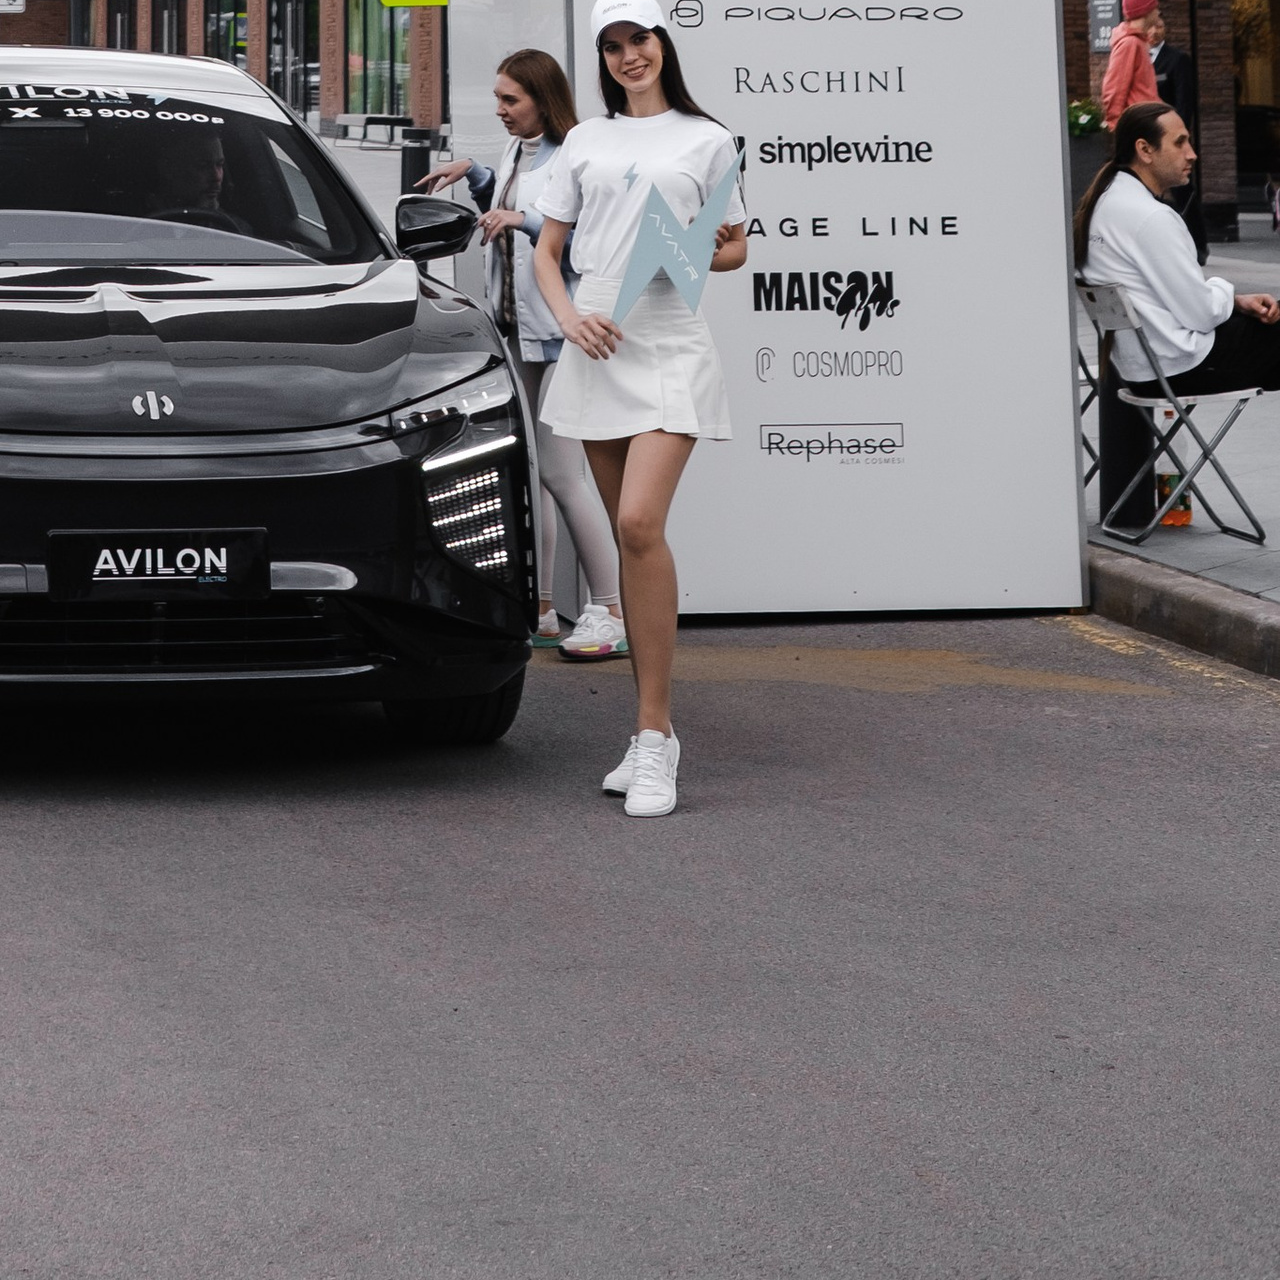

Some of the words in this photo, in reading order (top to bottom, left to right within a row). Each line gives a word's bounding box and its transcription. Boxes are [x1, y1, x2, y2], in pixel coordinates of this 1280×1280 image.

[725, 6, 964, 21] PIQUADRO
[63, 108, 93, 118] 13
[97, 108, 150, 120] 900
[758, 134, 934, 171] simplewine
[861, 216, 960, 237] LINE
[752, 270, 894, 312] MAISON
[793, 350, 904, 378] COSMOPRO
[767, 431, 898, 463] Rephase
[93, 547, 227, 575] AVILON
